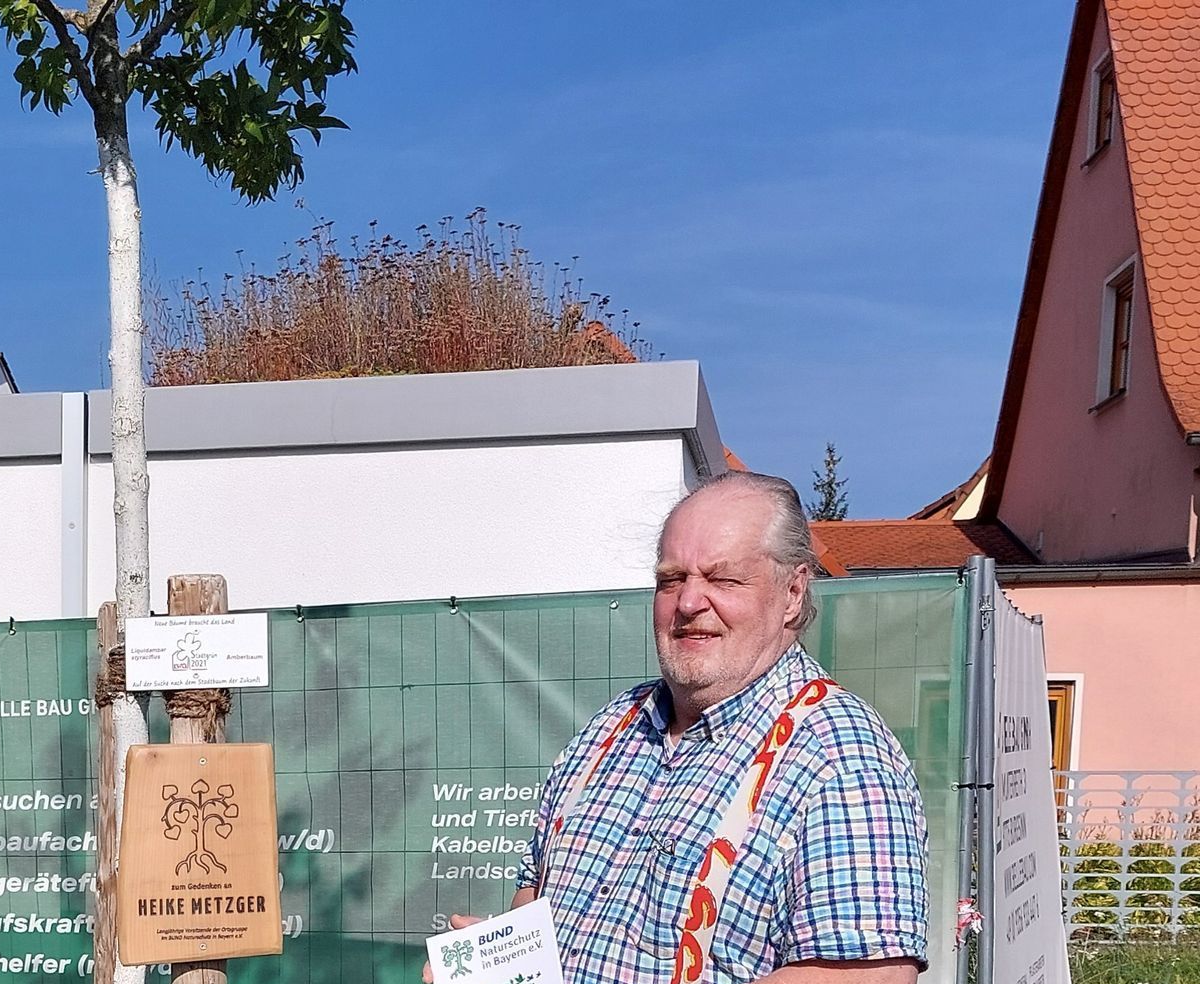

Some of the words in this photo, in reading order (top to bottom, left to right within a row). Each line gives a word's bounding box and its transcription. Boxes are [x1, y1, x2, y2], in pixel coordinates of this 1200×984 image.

[191, 659, 207, 667] 2021
[36, 699, 73, 716] BAU
[432, 784, 473, 801] Wir
[431, 810, 477, 827] und
[187, 882, 222, 890] Gedenken
[138, 898, 185, 916] HEIKE
[191, 896, 266, 914] METZGER
[478, 925, 514, 946] BUND
[479, 929, 541, 958] Naturschutz
[482, 960, 492, 970] in
[493, 948, 527, 966] Bayern
[528, 939, 543, 953] e.V.
